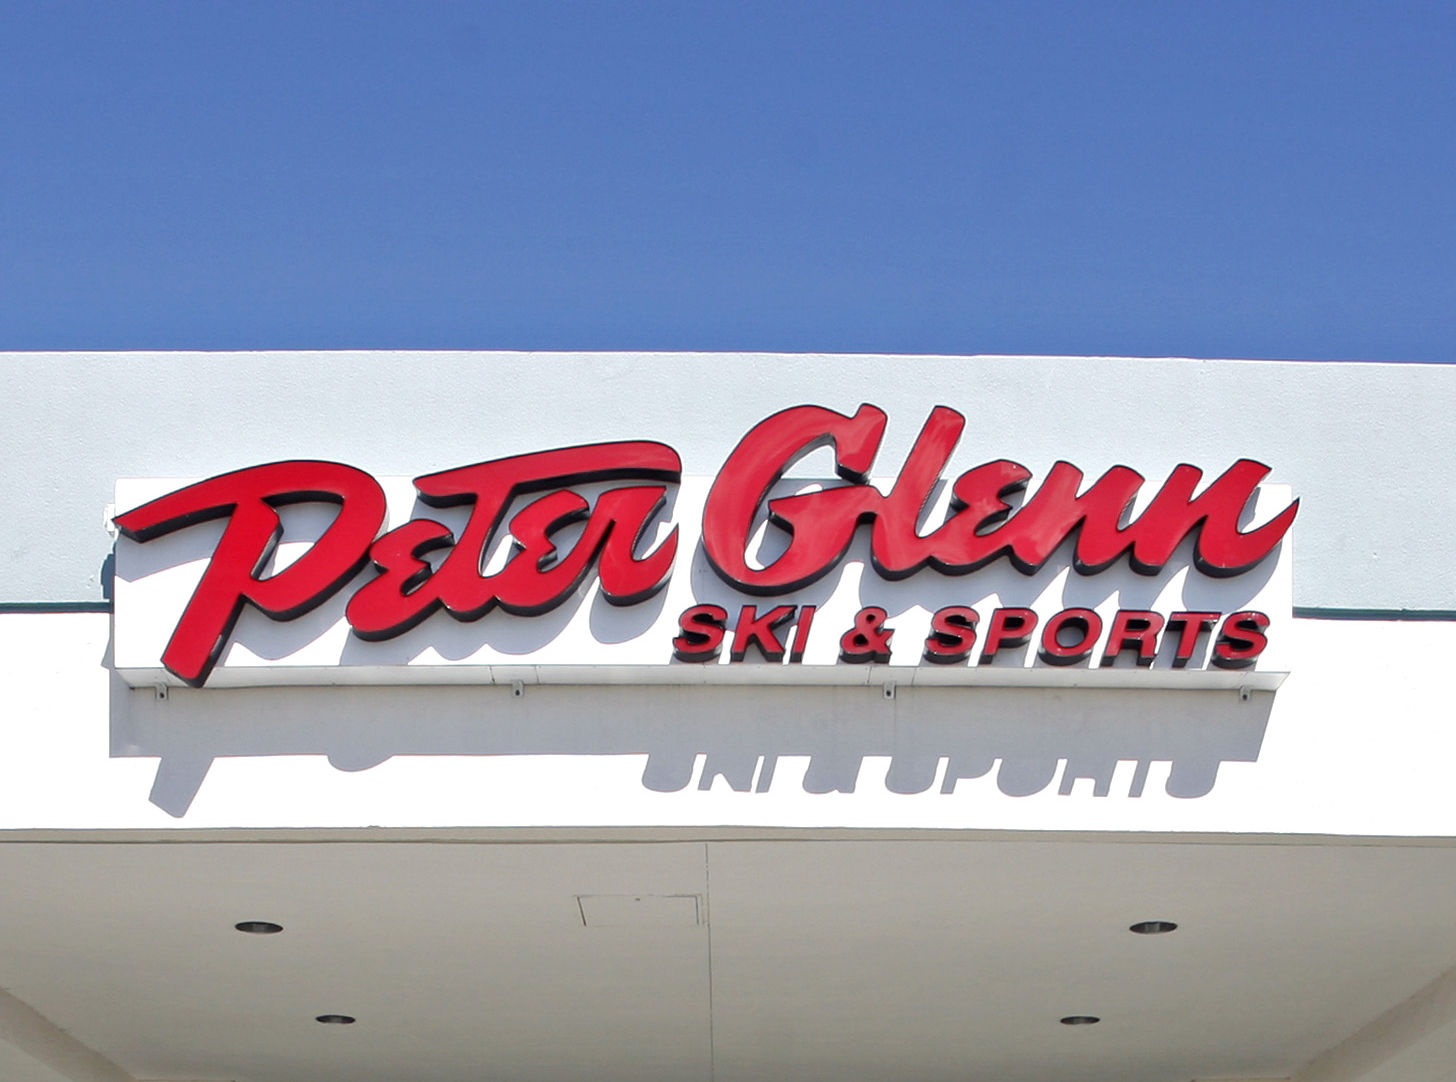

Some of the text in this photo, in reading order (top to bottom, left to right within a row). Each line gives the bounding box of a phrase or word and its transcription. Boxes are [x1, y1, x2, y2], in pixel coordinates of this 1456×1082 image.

[113, 402, 1300, 688] Peter Glenn
[672, 604, 1271, 668] SKI & SPORTS
